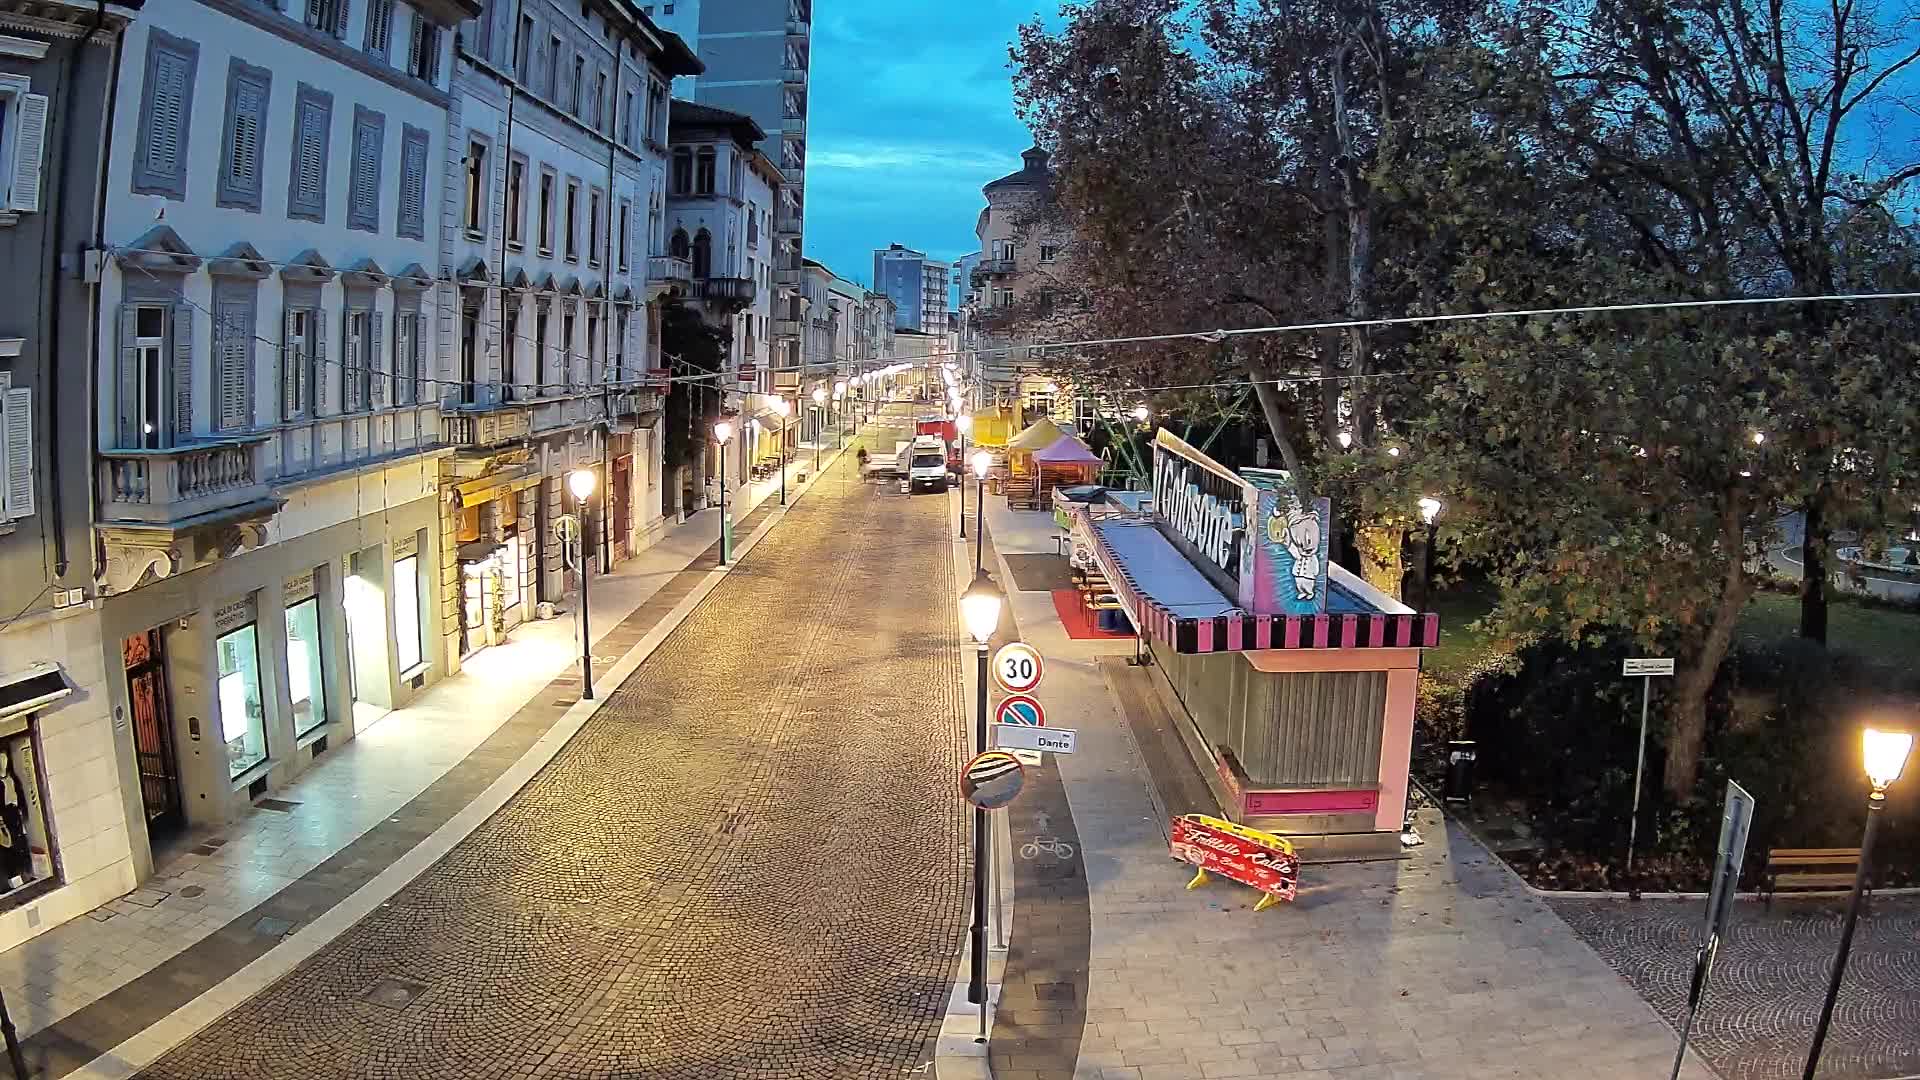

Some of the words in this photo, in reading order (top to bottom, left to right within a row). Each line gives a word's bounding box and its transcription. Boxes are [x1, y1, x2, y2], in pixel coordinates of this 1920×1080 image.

[1162, 458, 1233, 570] Golosone
[1005, 658, 1032, 679] 30
[1038, 737, 1070, 748] Dante
